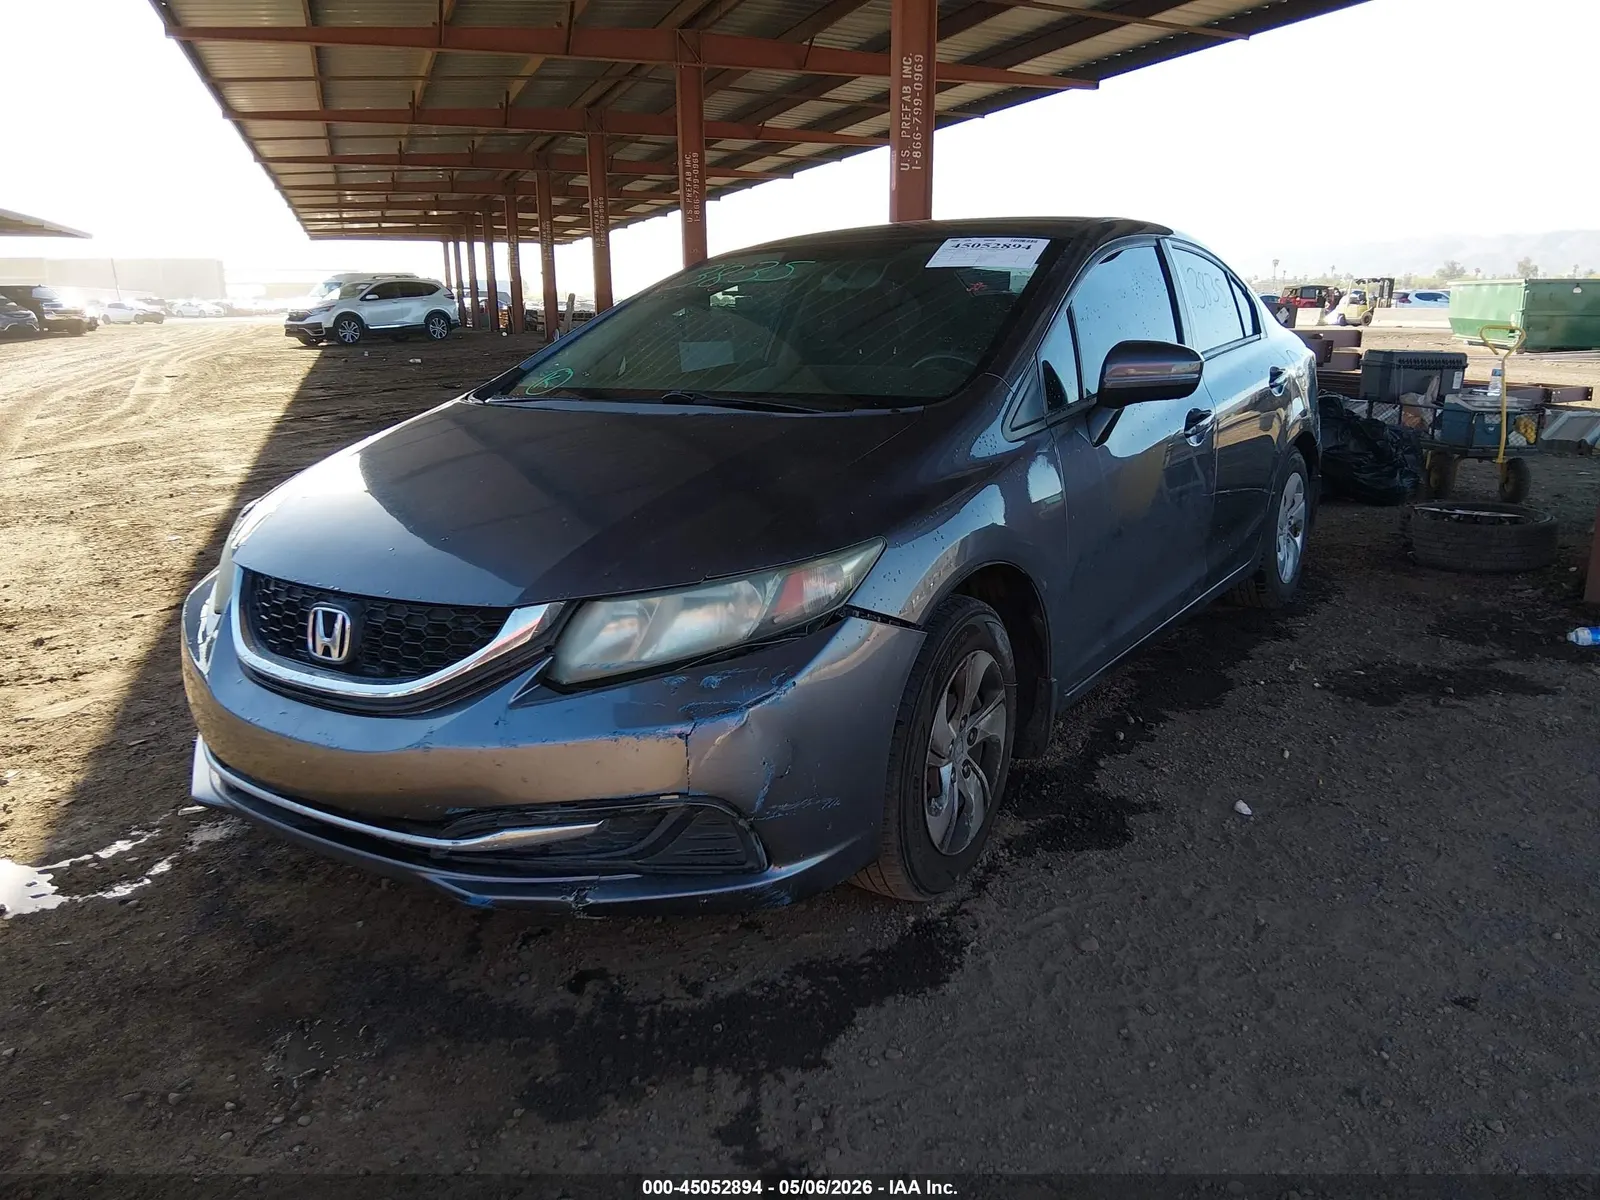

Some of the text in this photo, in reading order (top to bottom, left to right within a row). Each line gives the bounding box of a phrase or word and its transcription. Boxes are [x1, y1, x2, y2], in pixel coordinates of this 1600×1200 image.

[900, 53, 913, 171] U.S. PREFAB INC.
[912, 54, 924, 170] 1-866-799-0969
[685, 171, 693, 203] PREFAB
[951, 242, 1032, 250] 45052894
